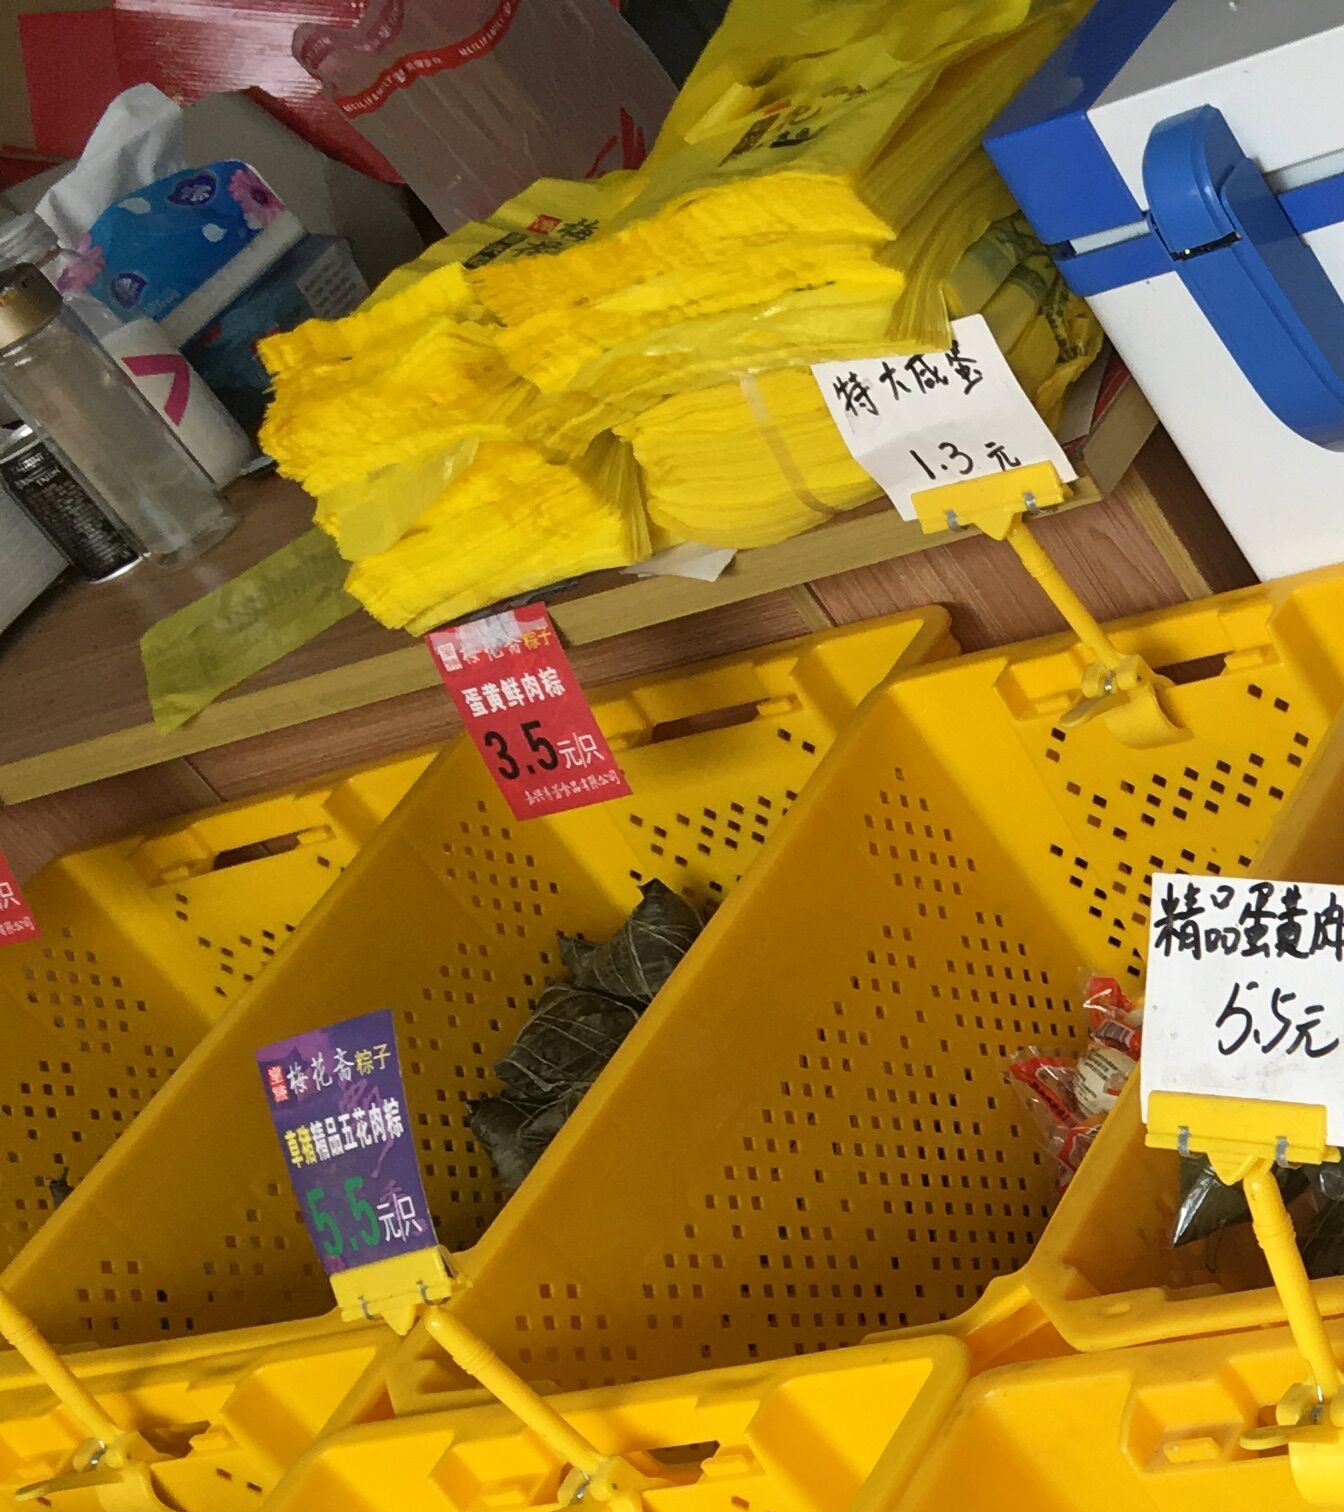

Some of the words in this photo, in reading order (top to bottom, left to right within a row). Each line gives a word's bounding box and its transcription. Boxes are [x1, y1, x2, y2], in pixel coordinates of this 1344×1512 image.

[832, 339, 983, 416] 特大咸蛋
[461, 666, 565, 717] 蛋黄鲜肉粽
[1216, 981, 1339, 1058] 5.5元
